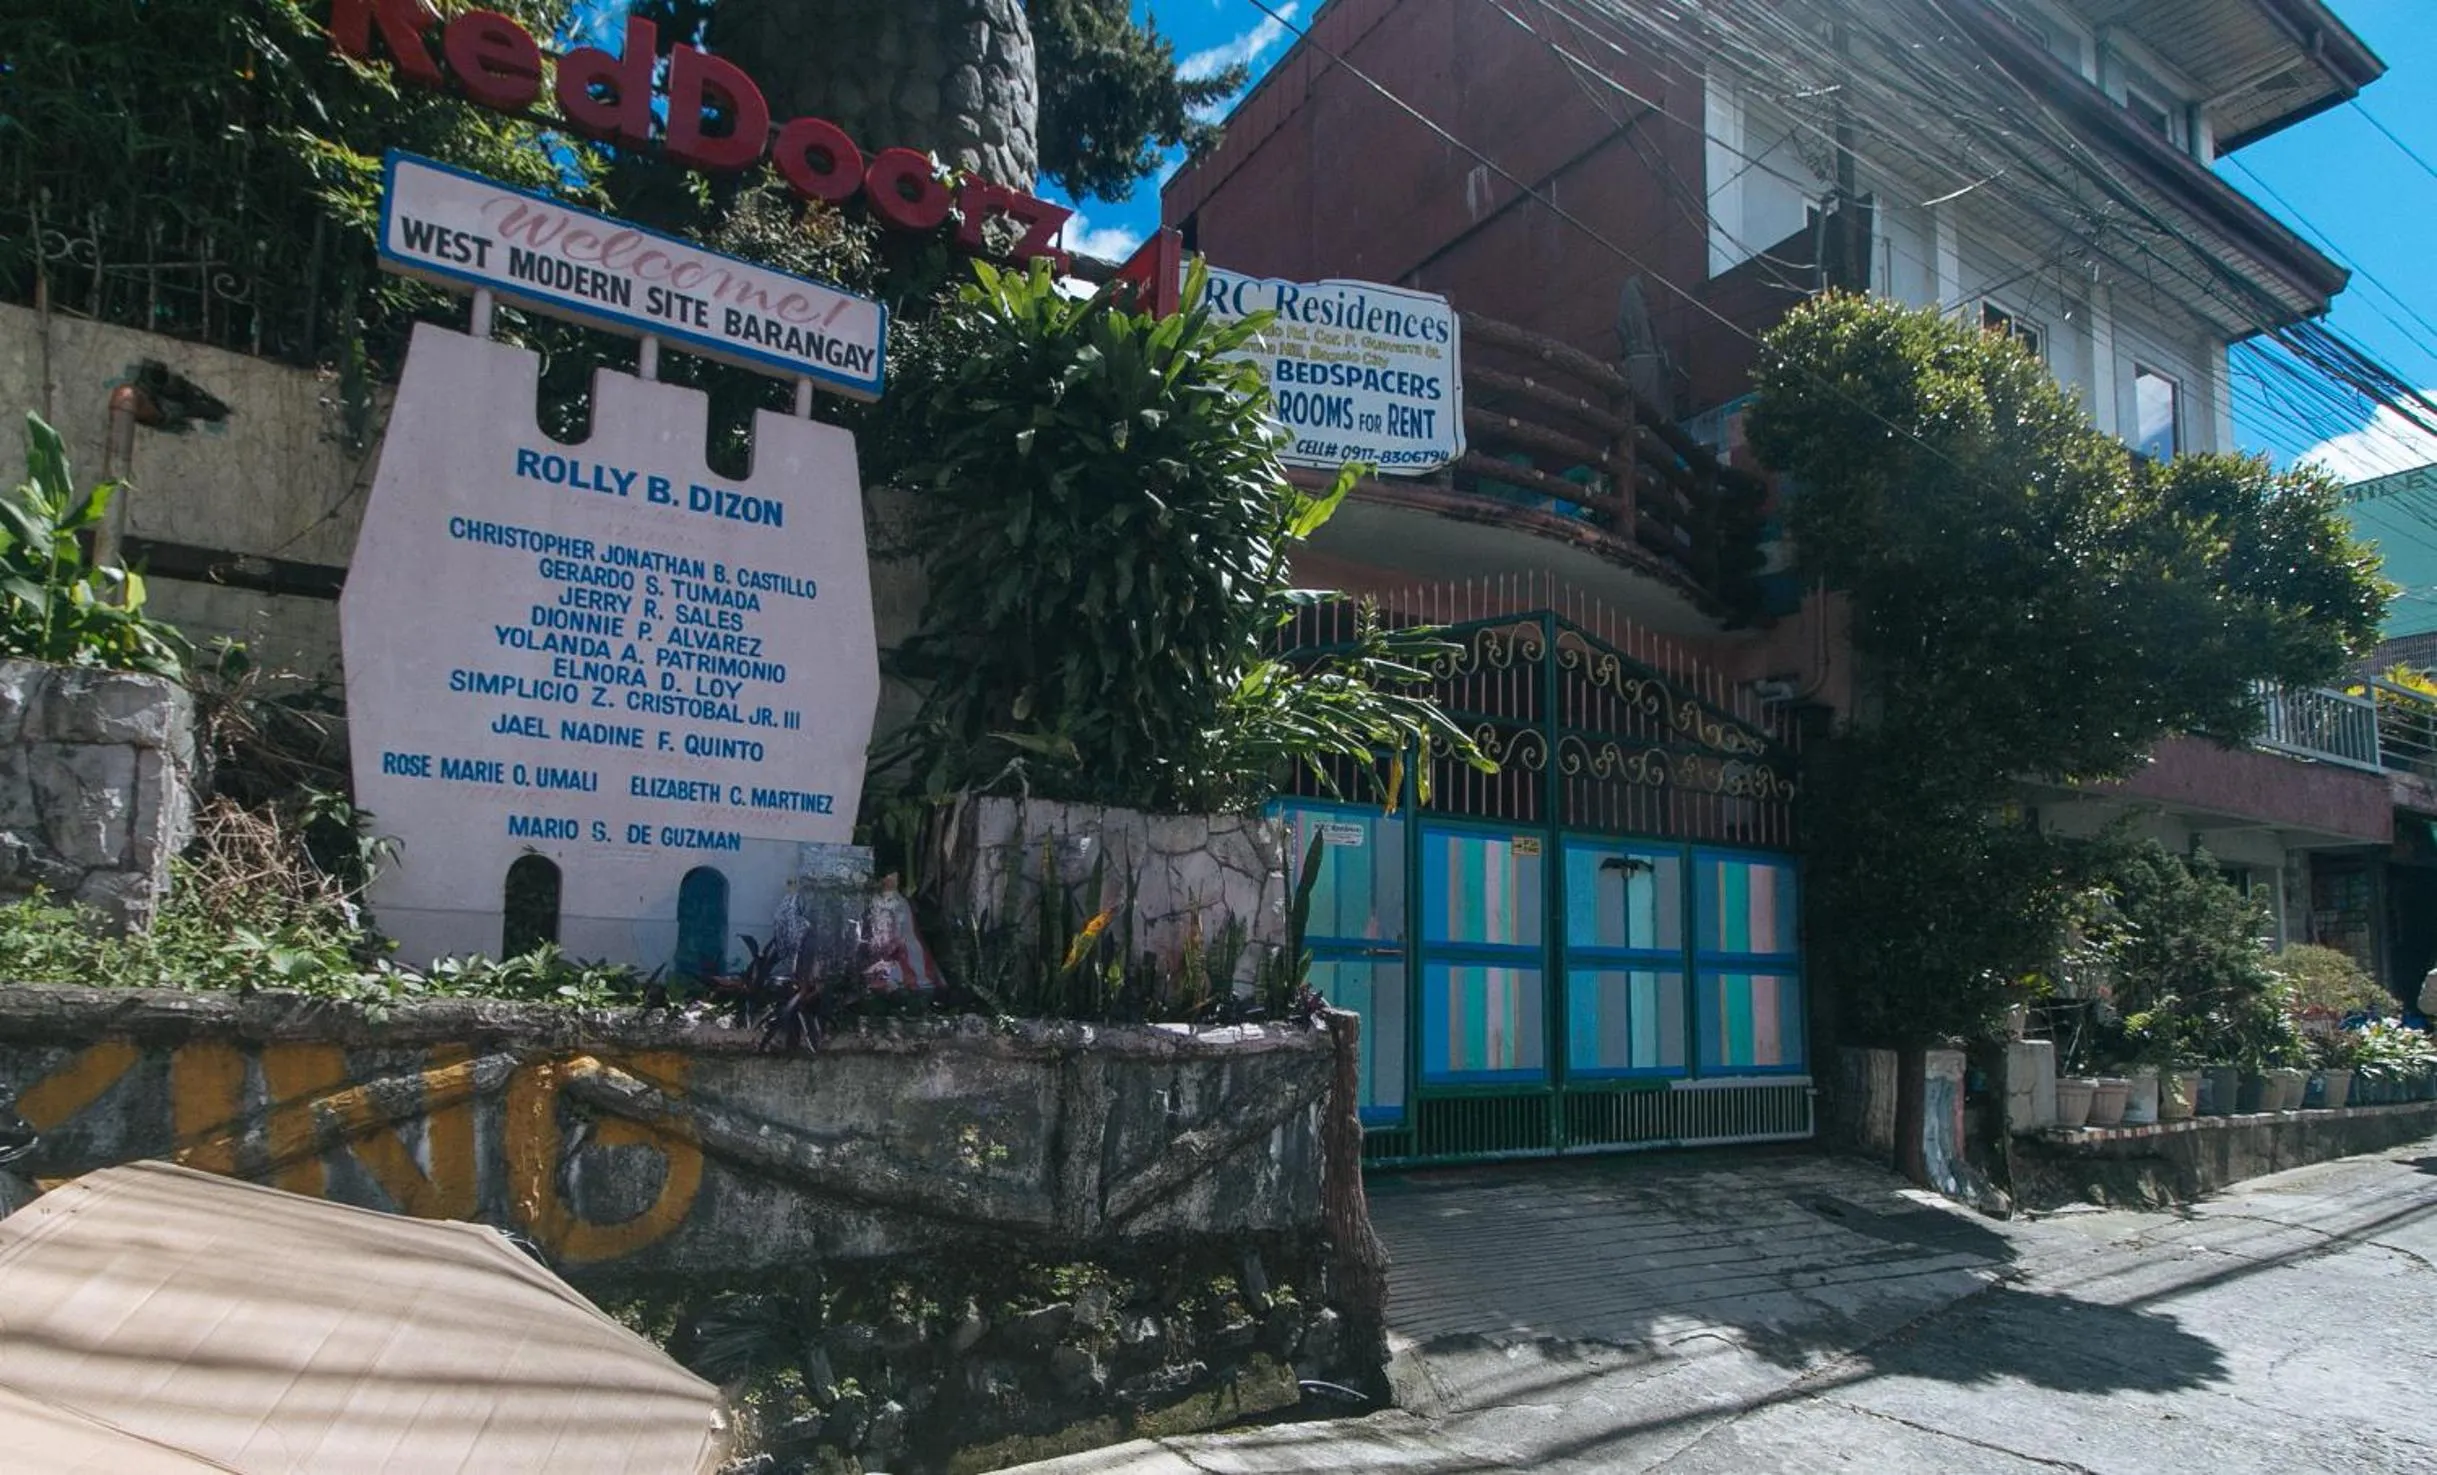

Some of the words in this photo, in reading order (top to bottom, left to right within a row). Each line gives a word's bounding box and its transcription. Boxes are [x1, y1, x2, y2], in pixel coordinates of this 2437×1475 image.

[480, 195, 852, 333] Welcome!
[401, 216, 493, 268] WEST
[508, 246, 631, 307] MODERN
[646, 286, 709, 329] SITE
[724, 307, 876, 374] BARANGAY
[1275, 284, 1449, 344] Residences
[1276, 358, 1441, 400] BEDSPACERS
[1279, 390, 1353, 430] ROOMS
[1359, 412, 1382, 433] FOR
[1388, 402, 1435, 439] RENT
[1296, 439, 1338, 458] CELL#
[517, 447, 638, 496] ROLLY
[647, 475, 679, 506] B.
[689, 484, 783, 528] DIZON
[450, 516, 595, 561] CHRISTOPHER
[600, 544, 705, 580] JONATHAN
[714, 563, 731, 585] B.
[737, 568, 817, 600] CASTILLO
[539, 558, 635, 591] GERARDO
[645, 575, 664, 596] S.
[671, 579, 761, 612] TUMADA
[559, 587, 632, 615] JERRY
[644, 598, 664, 621] R.
[676, 603, 743, 632] SALES
[495, 625, 611, 659] YOLANDA
[621, 643, 645, 664] A.
[656, 648, 786, 684] PATRIMONIO
[532, 605, 624, 638] DIONNIE
[638, 621, 653, 642] P.
[667, 626, 762, 657] ALVAREZ
[449, 669, 578, 704] SIMPLICIO
[591, 687, 615, 708] Z.
[626, 691, 744, 724] CRISTOBAL
[749, 706, 779, 729] JR.
[784, 710, 800, 730] III
[553, 657, 647, 688] ELNORA
[660, 671, 683, 693] D.
[696, 676, 743, 699] LOY
[491, 713, 551, 739] JAEL
[561, 720, 645, 748] NADINE
[658, 731, 675, 751] F.
[684, 734, 764, 762] QUINTO
[383, 751, 431, 778] ROSE
[440, 757, 504, 784] MARIE
[512, 764, 531, 788] O.
[536, 766, 598, 792] UMALI
[631, 775, 720, 804] ELIZABETH
[729, 786, 746, 806] C.
[751, 788, 833, 815] MARTINEZ
[508, 815, 579, 840] MARIO
[592, 821, 612, 843] S.
[627, 824, 651, 845] DE
[661, 826, 741, 852] GUZMAN
